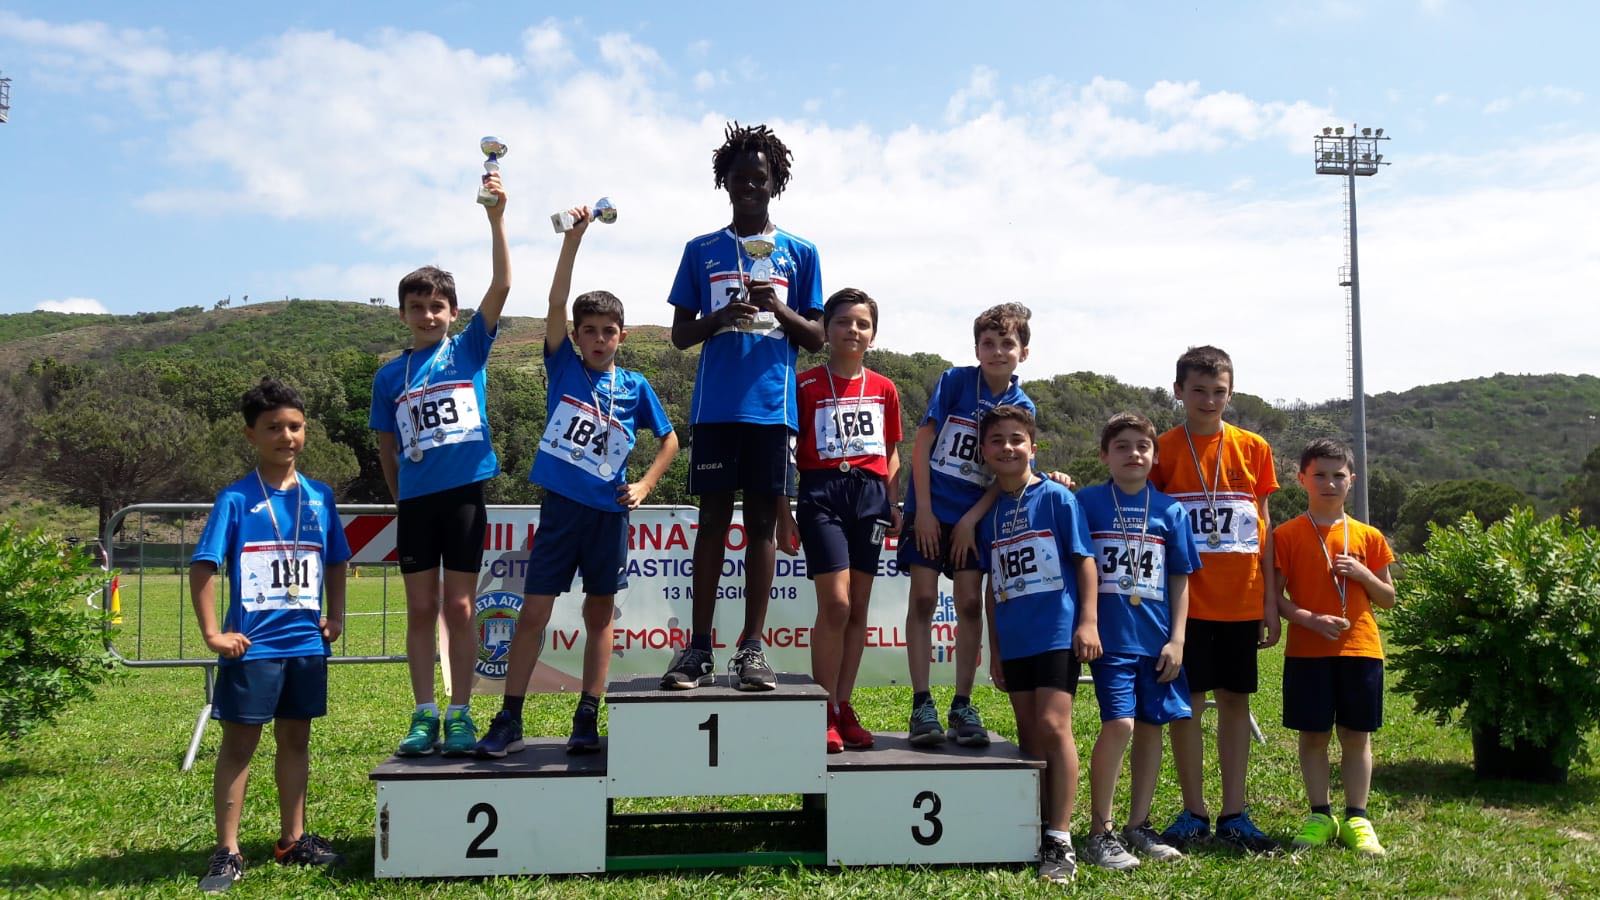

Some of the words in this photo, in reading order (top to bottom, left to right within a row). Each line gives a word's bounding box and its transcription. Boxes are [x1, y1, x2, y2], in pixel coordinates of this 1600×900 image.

[411, 397, 459, 431] 183
[833, 411, 874, 438] 188
[563, 415, 610, 456] 184
[1189, 508, 1233, 534] 187
[271, 559, 310, 588] 181
[1000, 546, 1038, 579] 182
[1103, 546, 1153, 578] 344
[663, 586, 680, 599] 13
[553, 629, 580, 650] IV
[698, 713, 719, 768] 1
[465, 802, 499, 859] 2
[911, 791, 944, 846] 3
